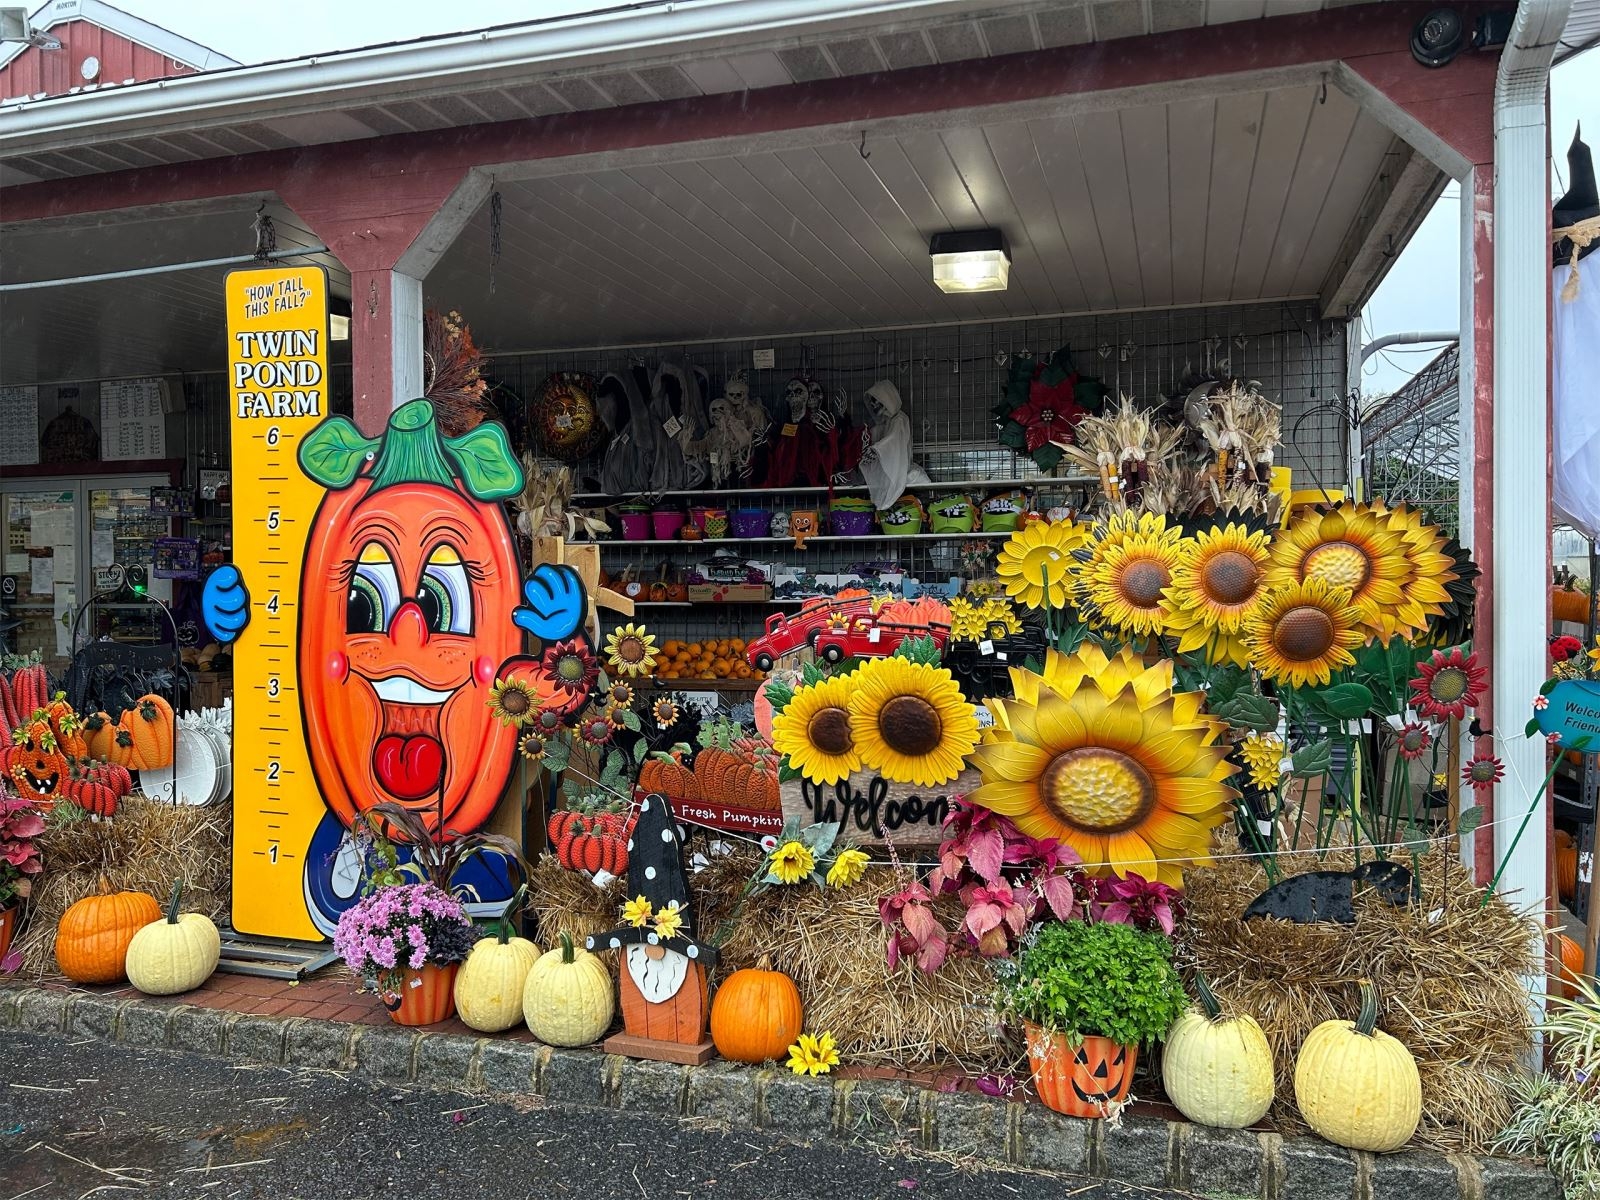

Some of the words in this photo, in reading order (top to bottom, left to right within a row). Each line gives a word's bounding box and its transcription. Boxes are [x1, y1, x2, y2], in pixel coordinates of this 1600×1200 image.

[245, 283, 275, 302] "HOW
[278, 277, 304, 295] TALL
[245, 301, 269, 318] THIS
[274, 290, 311, 312] FALL?"
[236, 329, 318, 358] TWIN
[234, 360, 322, 388] POND
[237, 390, 320, 418] FARM
[267, 427, 279, 445] 6
[268, 511, 280, 529] 5
[267, 595, 279, 613] 4
[268, 678, 279, 696] 3
[268, 762, 280, 780] 2
[682, 805, 717, 819] Fresh
[723, 809, 786, 827] Pumpkin
[801, 776, 962, 839] Welcom
[269, 845, 278, 863] 1
